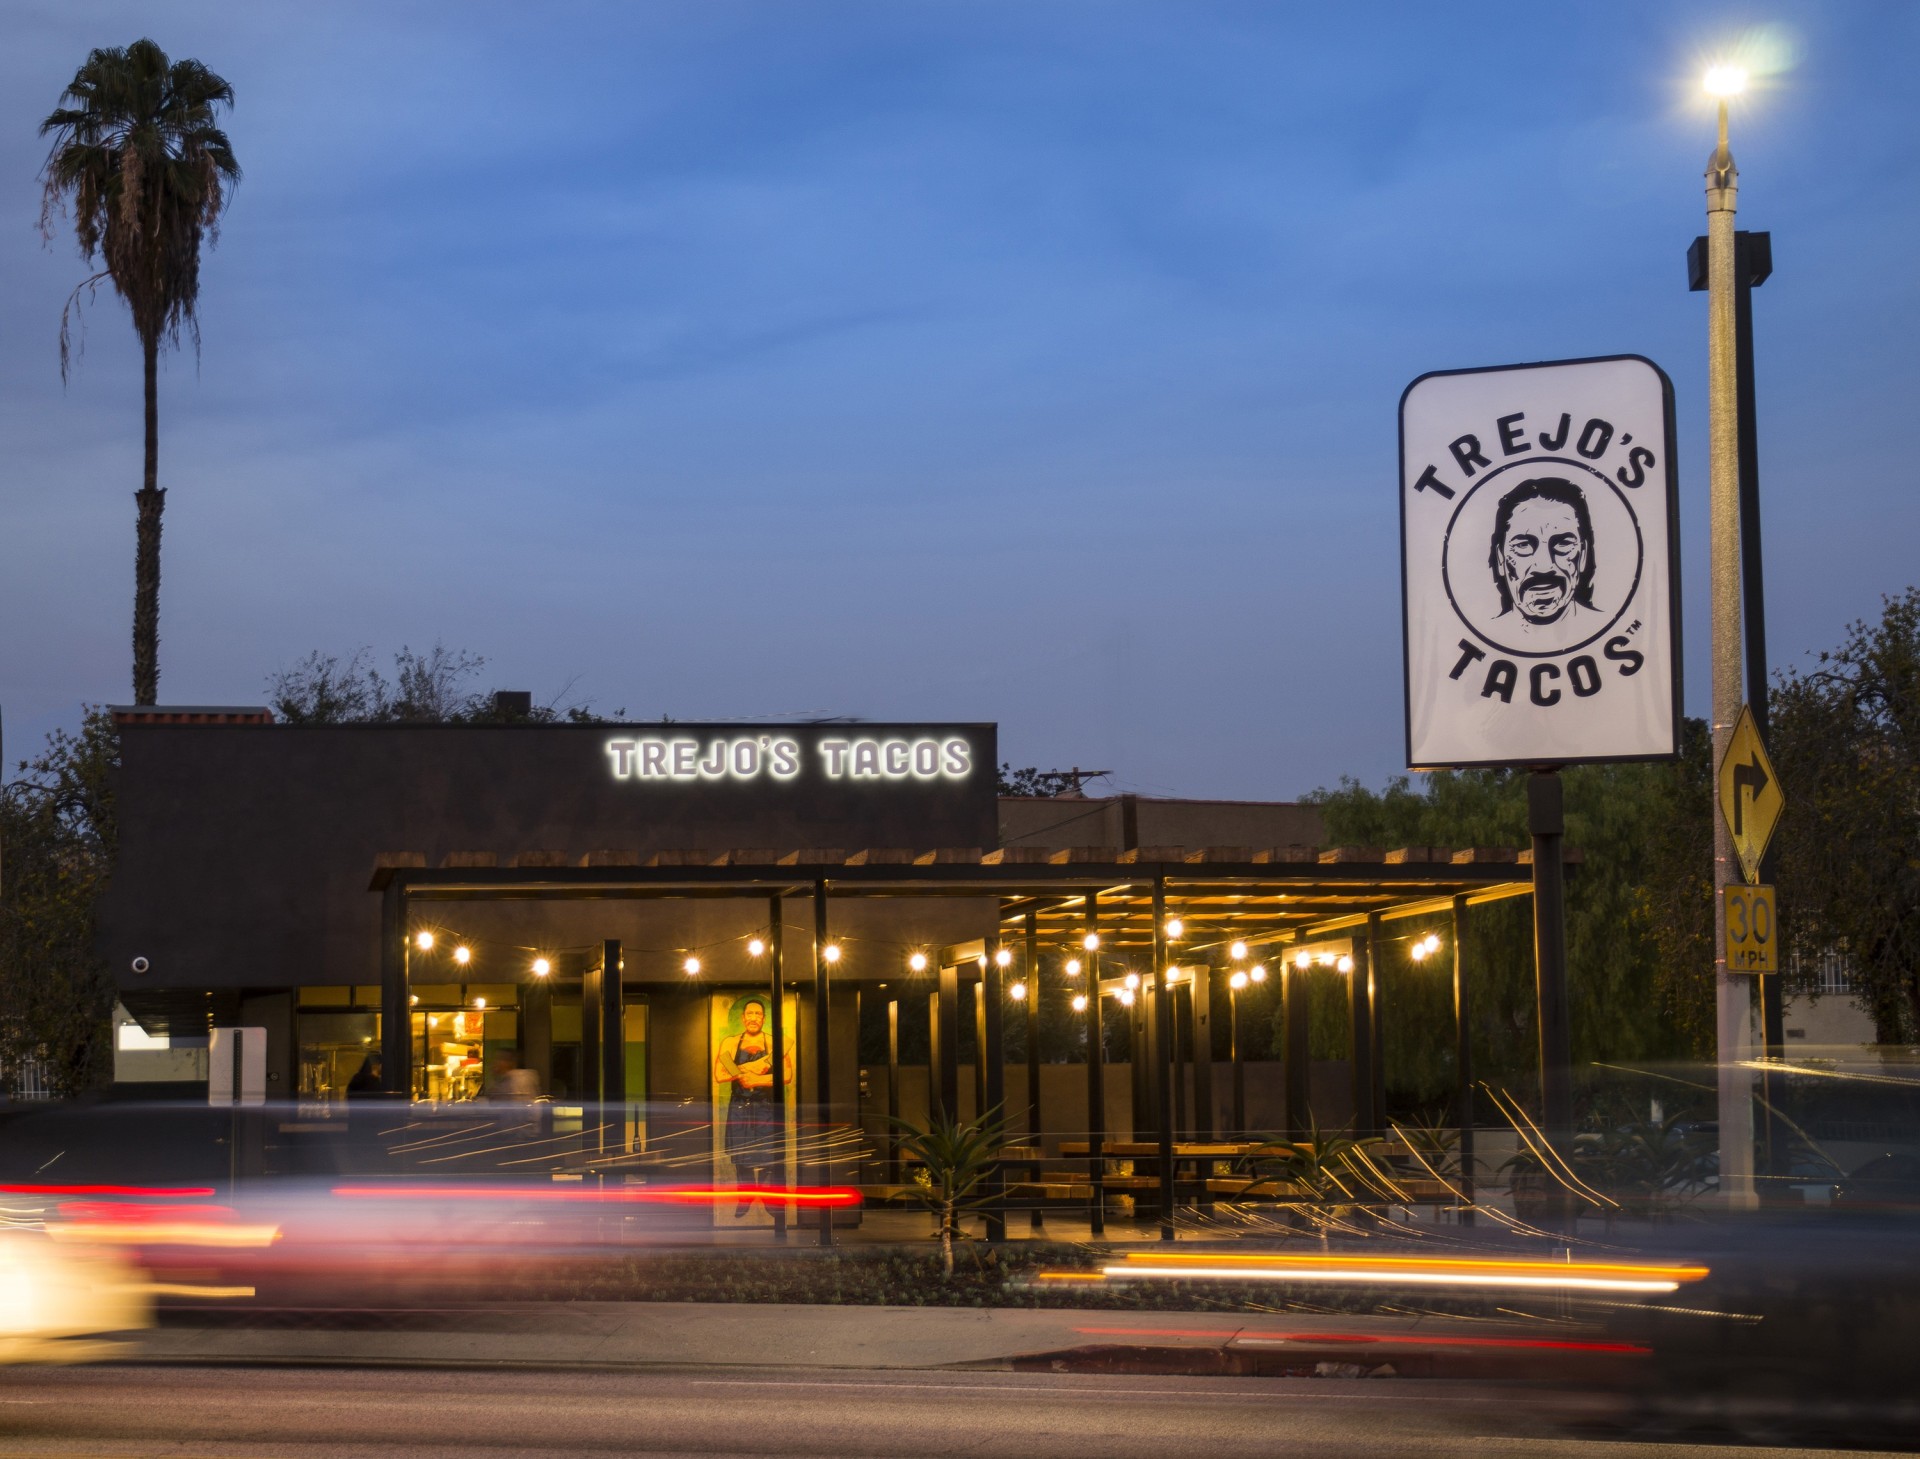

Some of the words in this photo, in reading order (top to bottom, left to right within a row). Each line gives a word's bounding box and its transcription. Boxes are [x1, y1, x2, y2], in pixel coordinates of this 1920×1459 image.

[1414, 412, 1655, 500] TREJO'S
[1449, 635, 1644, 707] TACOS
[608, 736, 799, 776] TREJO'S
[822, 739, 972, 776] TACOS
[1730, 895, 1771, 944] 30
[1734, 950, 1769, 968] MPH
